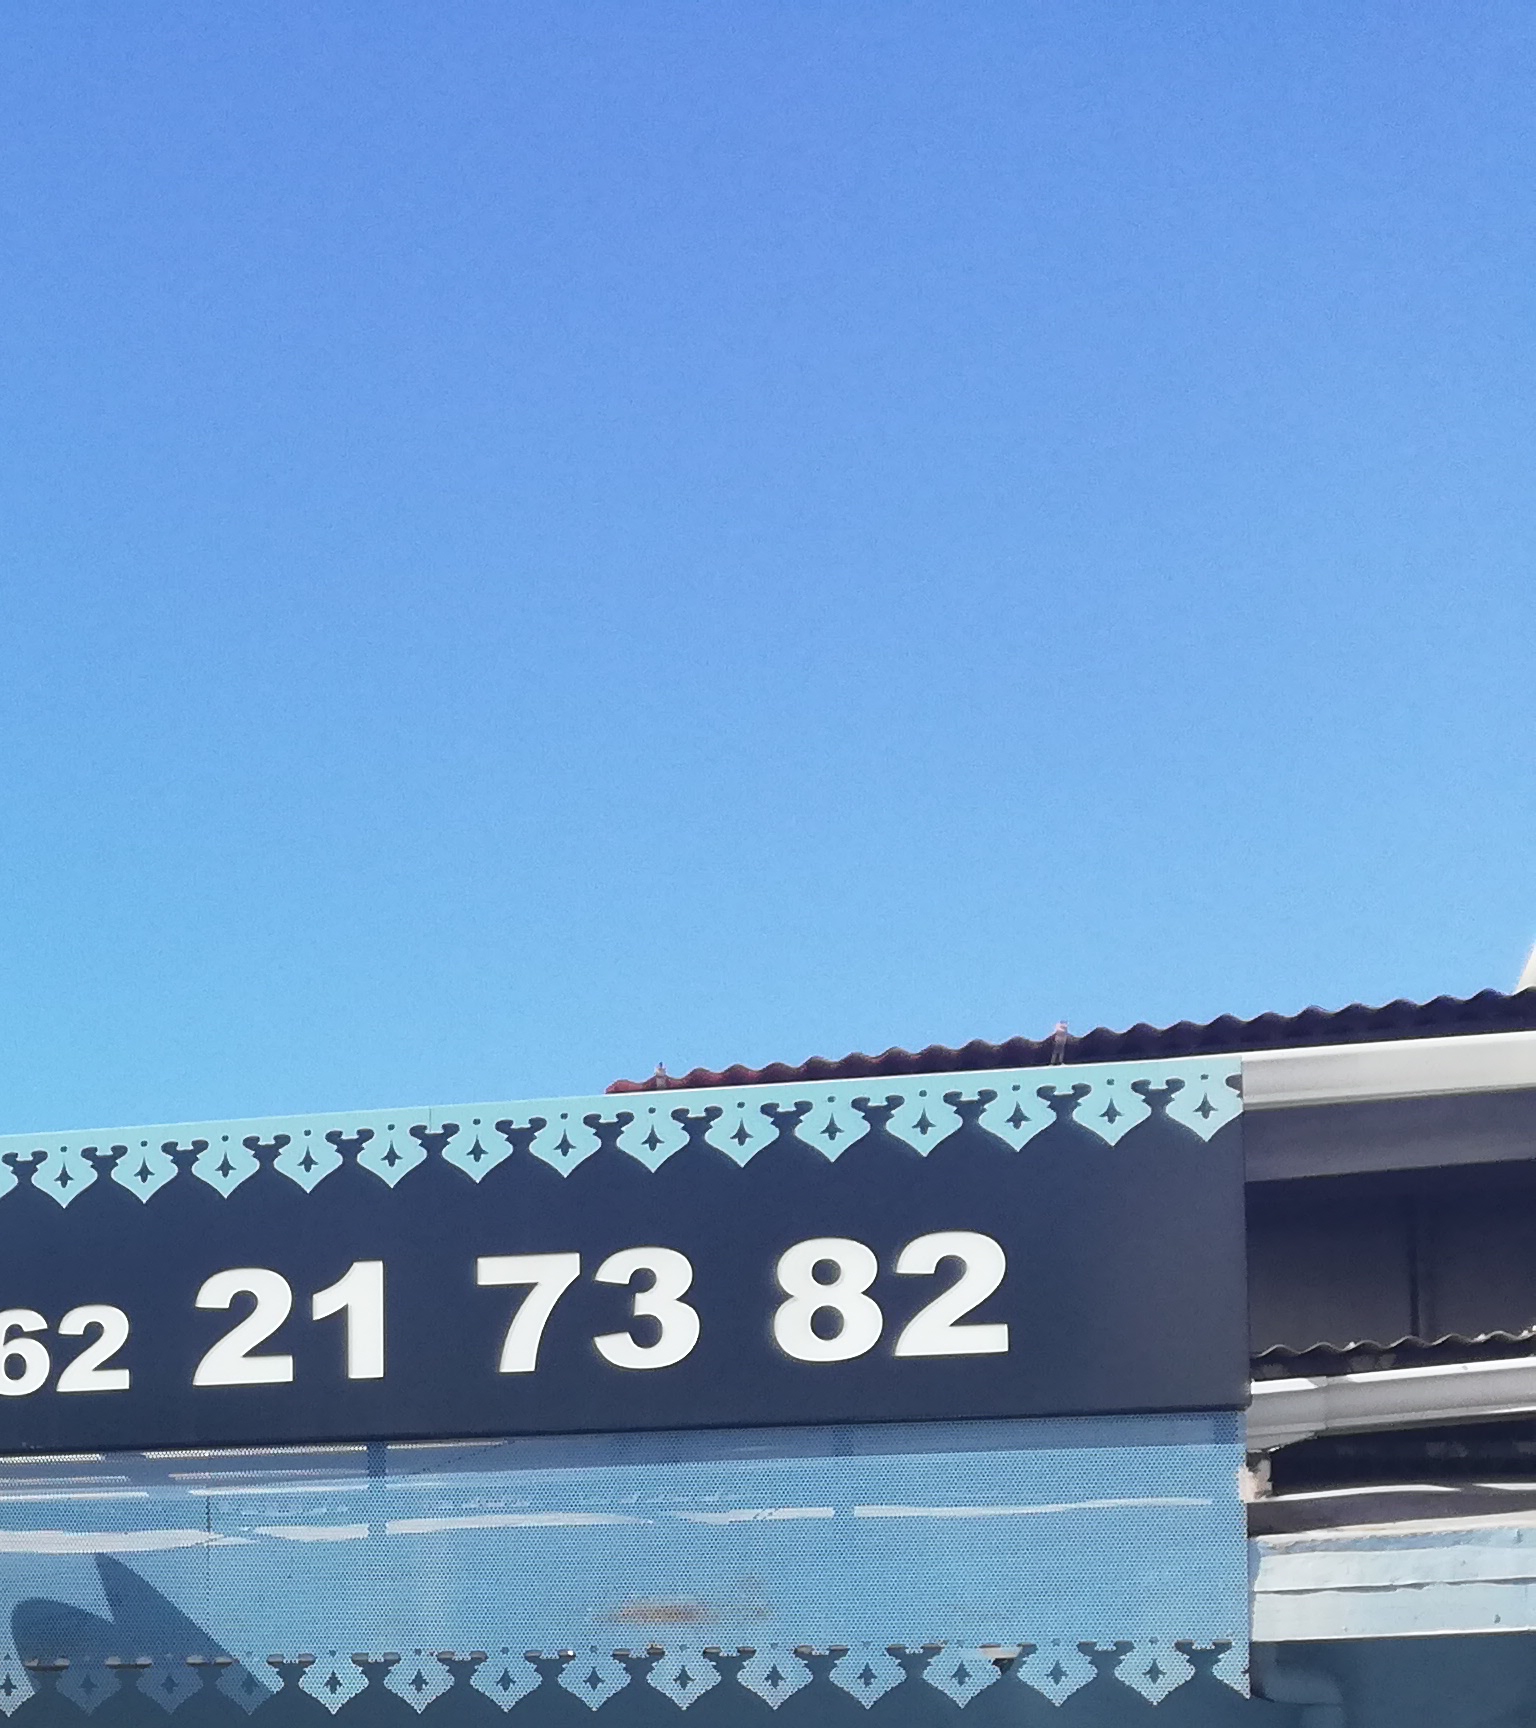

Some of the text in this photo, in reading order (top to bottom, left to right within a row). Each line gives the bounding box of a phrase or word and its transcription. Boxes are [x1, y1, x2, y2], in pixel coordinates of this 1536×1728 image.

[192, 1260, 386, 1388] 21
[476, 1246, 702, 1374] 73
[771, 1230, 1010, 1363] 82
